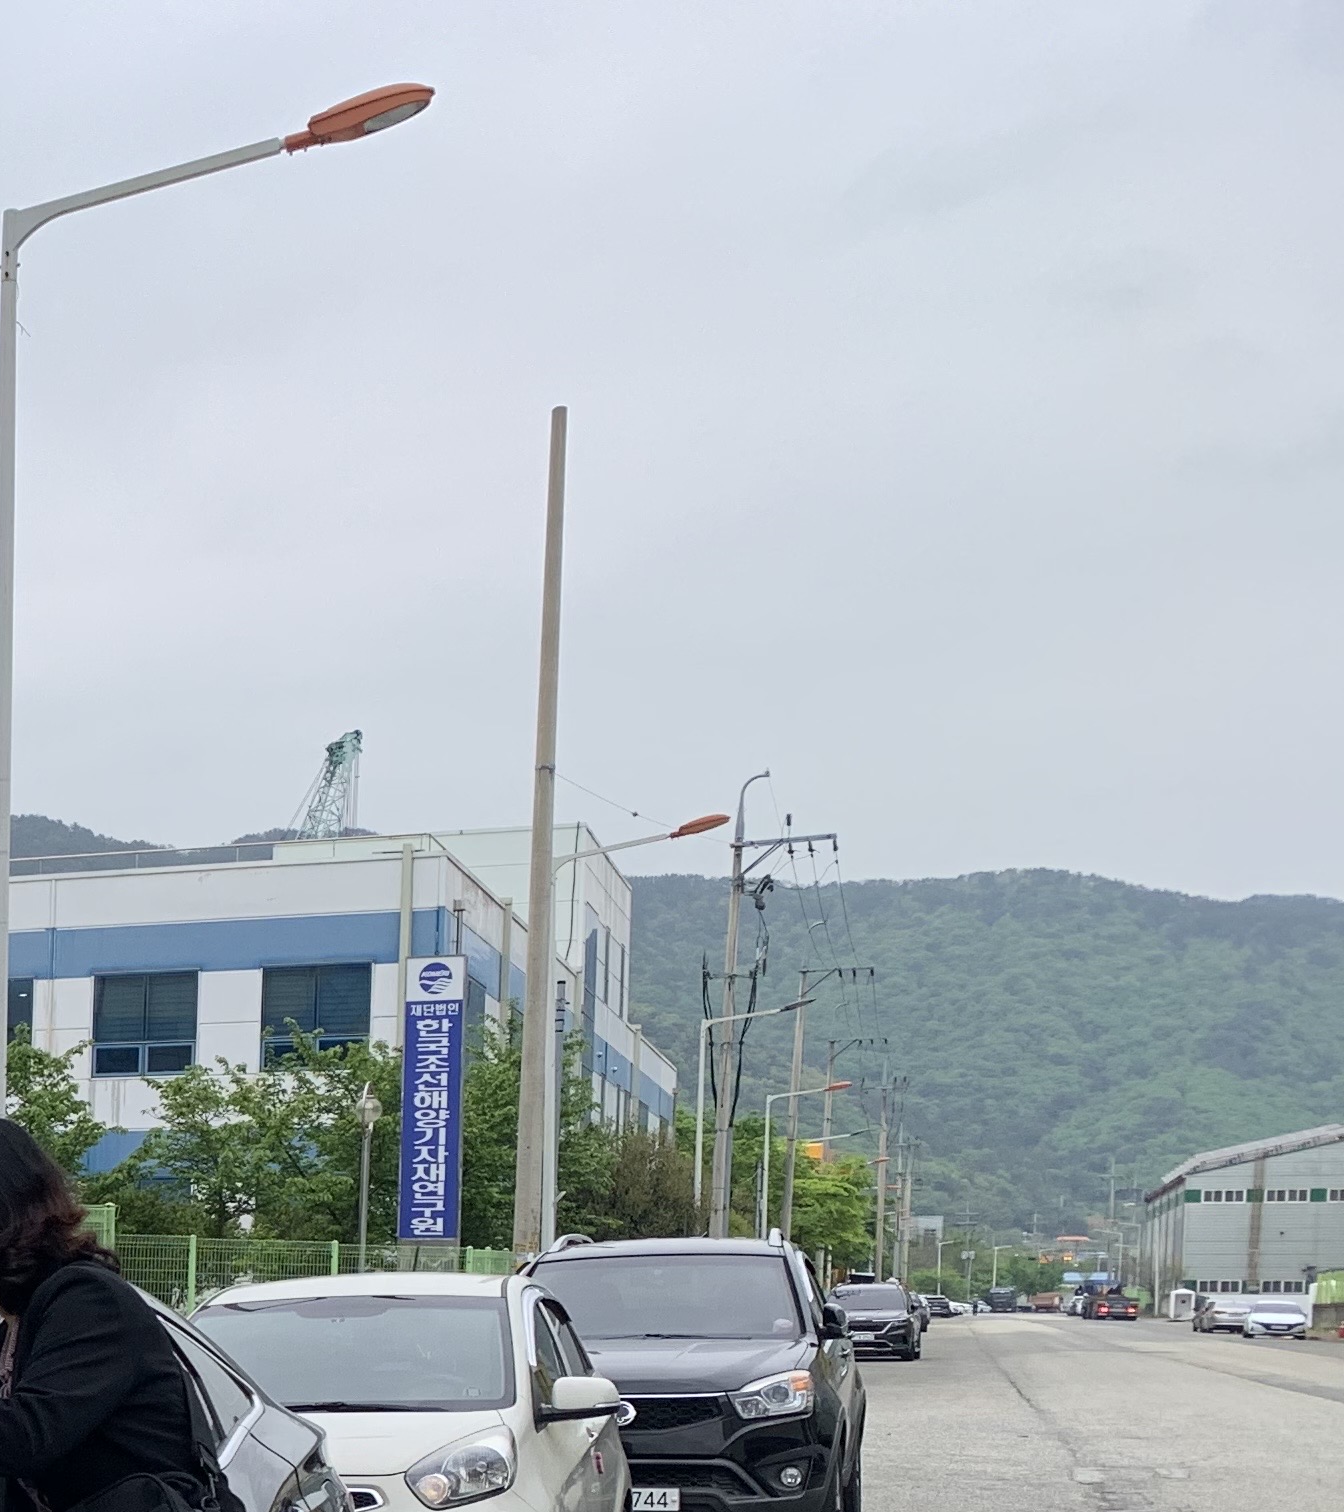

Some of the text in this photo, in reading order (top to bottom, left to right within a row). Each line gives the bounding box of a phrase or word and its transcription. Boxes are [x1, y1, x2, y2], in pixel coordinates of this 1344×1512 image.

[410, 1003, 459, 1016] 재단법인
[410, 1018, 453, 1235] 한국조선해양기자재연구원
[632, 1491, 668, 1508] 744
